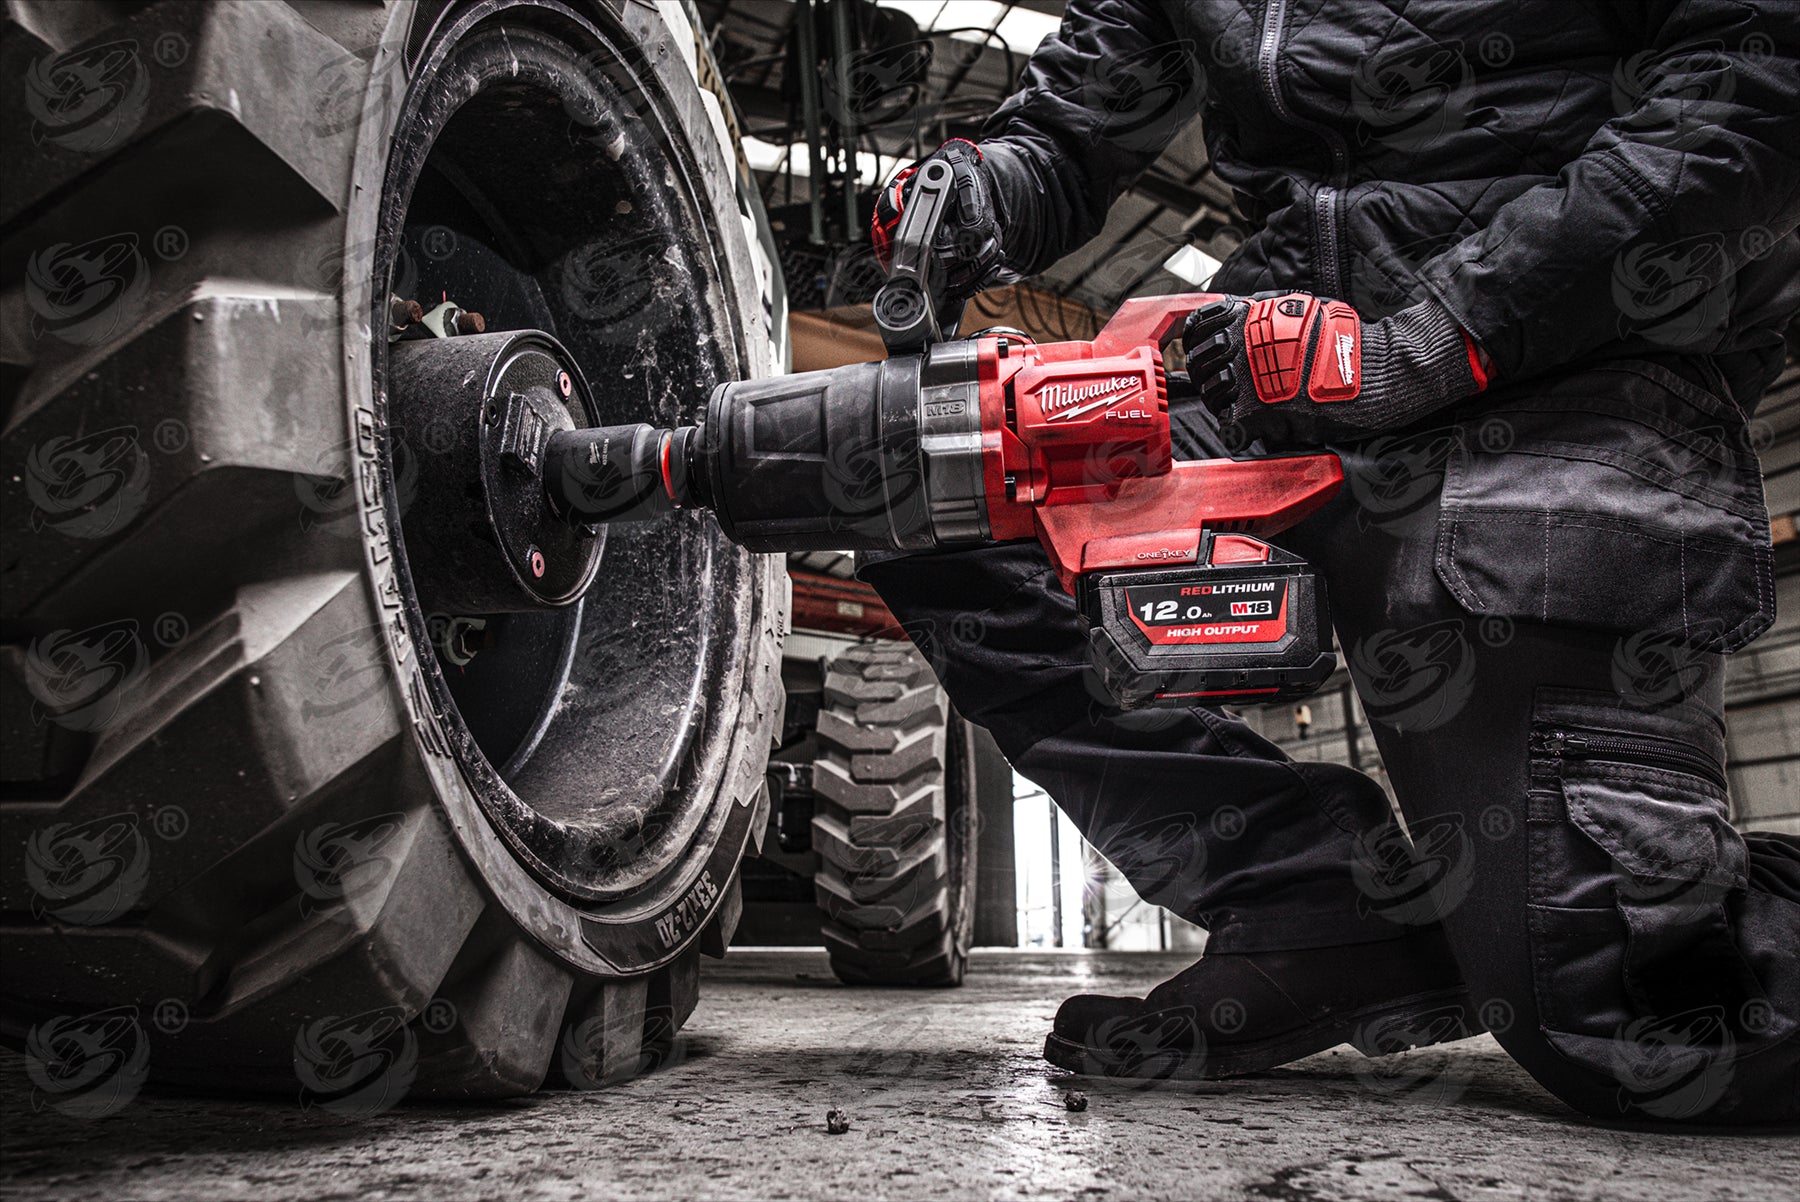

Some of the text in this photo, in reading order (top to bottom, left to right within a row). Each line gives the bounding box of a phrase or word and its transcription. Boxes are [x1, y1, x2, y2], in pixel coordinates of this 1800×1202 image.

[1034, 375, 1141, 414] Milwaukee
[926, 402, 965, 417] M18
[1105, 409, 1153, 420] FUEL
[1180, 582, 1275, 597] REDLITHIUM
[1232, 602, 1270, 615] M18
[1166, 625, 1260, 638] HIGH OUTPUT
